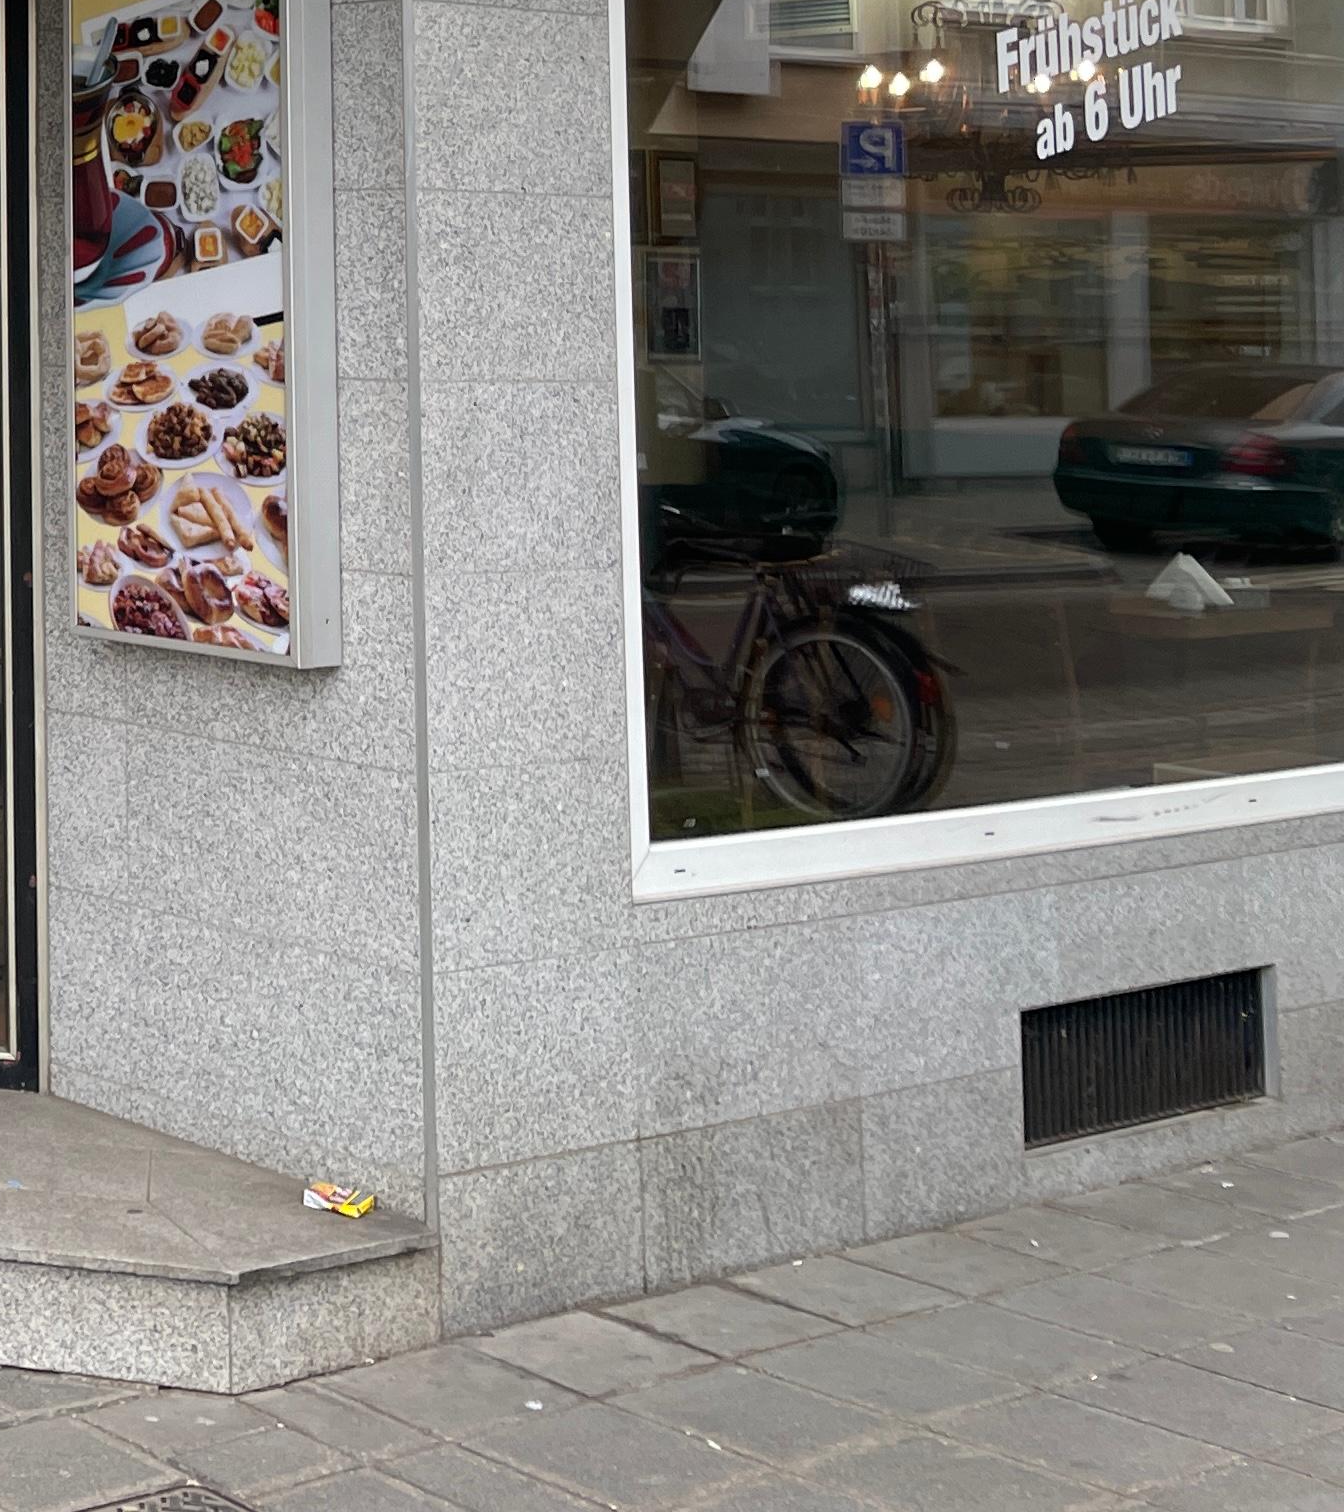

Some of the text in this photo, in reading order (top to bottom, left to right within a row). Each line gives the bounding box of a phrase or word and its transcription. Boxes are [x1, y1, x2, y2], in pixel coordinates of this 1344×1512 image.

[1036, 61, 1181, 160] ab 6 Uhr
